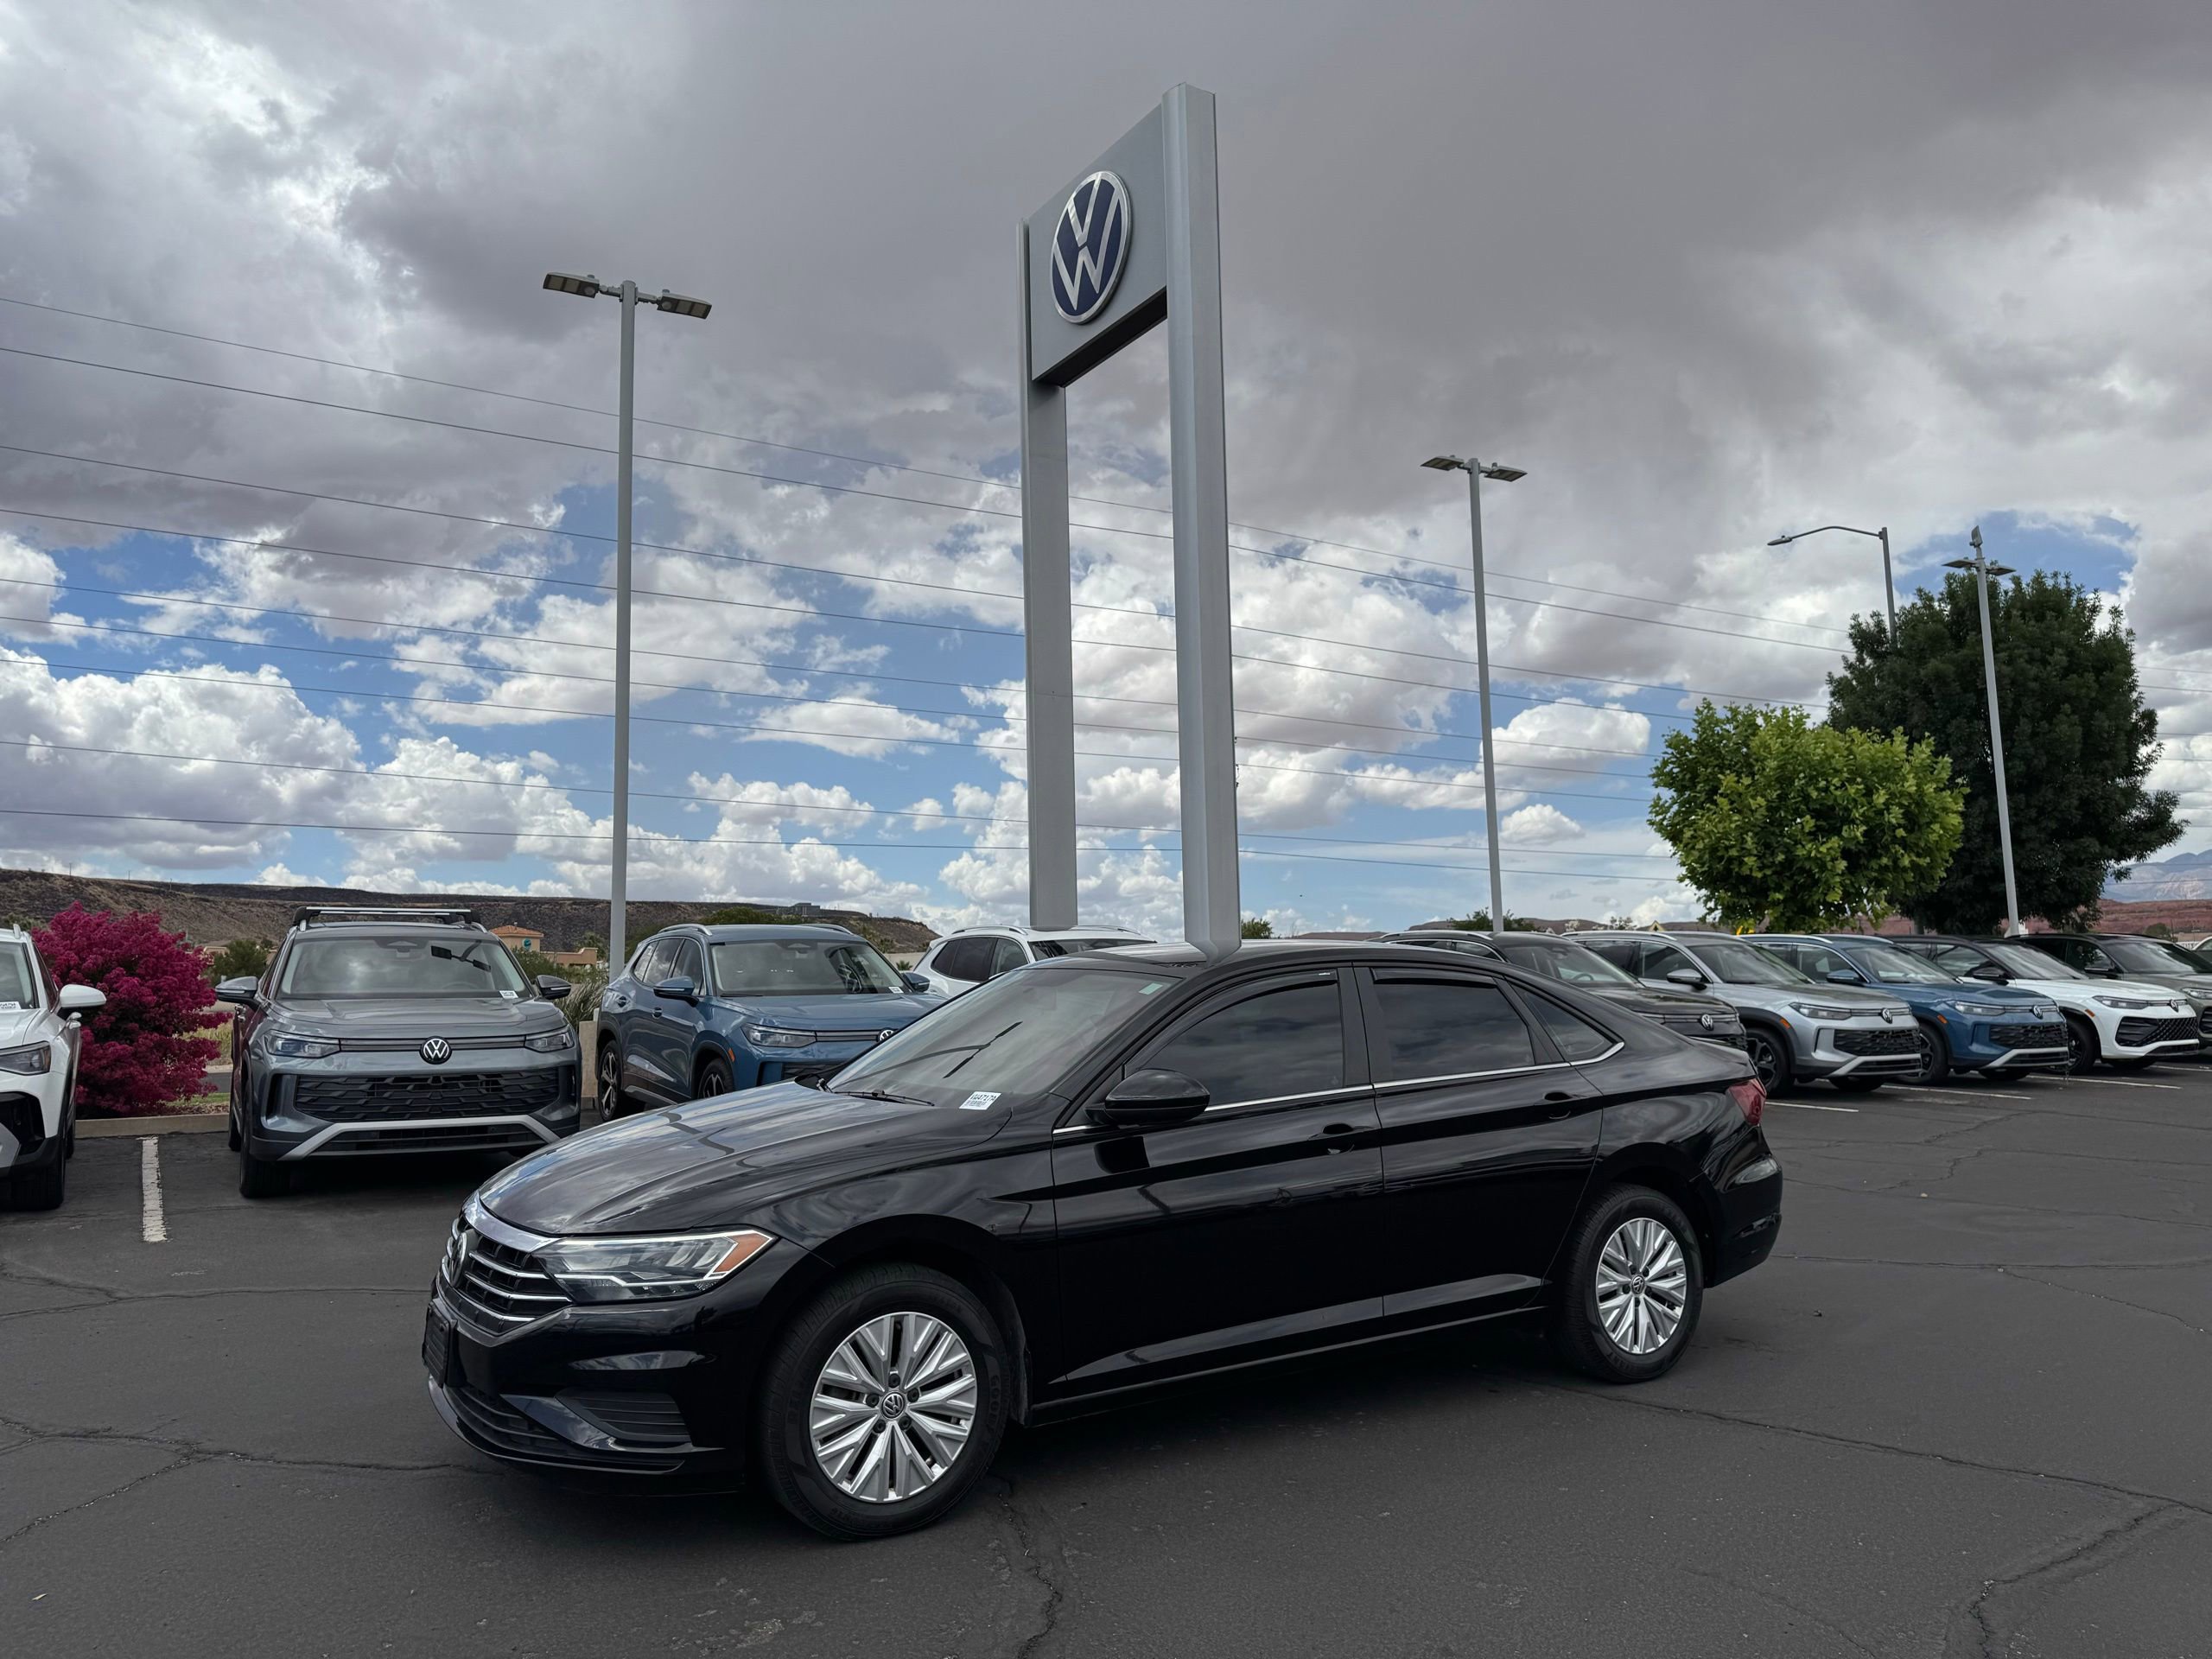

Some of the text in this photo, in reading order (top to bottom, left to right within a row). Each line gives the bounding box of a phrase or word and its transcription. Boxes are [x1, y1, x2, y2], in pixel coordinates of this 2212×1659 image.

[1052, 172, 1125, 315] VW
[424, 1039, 448, 1059] VW
[882, 1393, 905, 1417] VW
